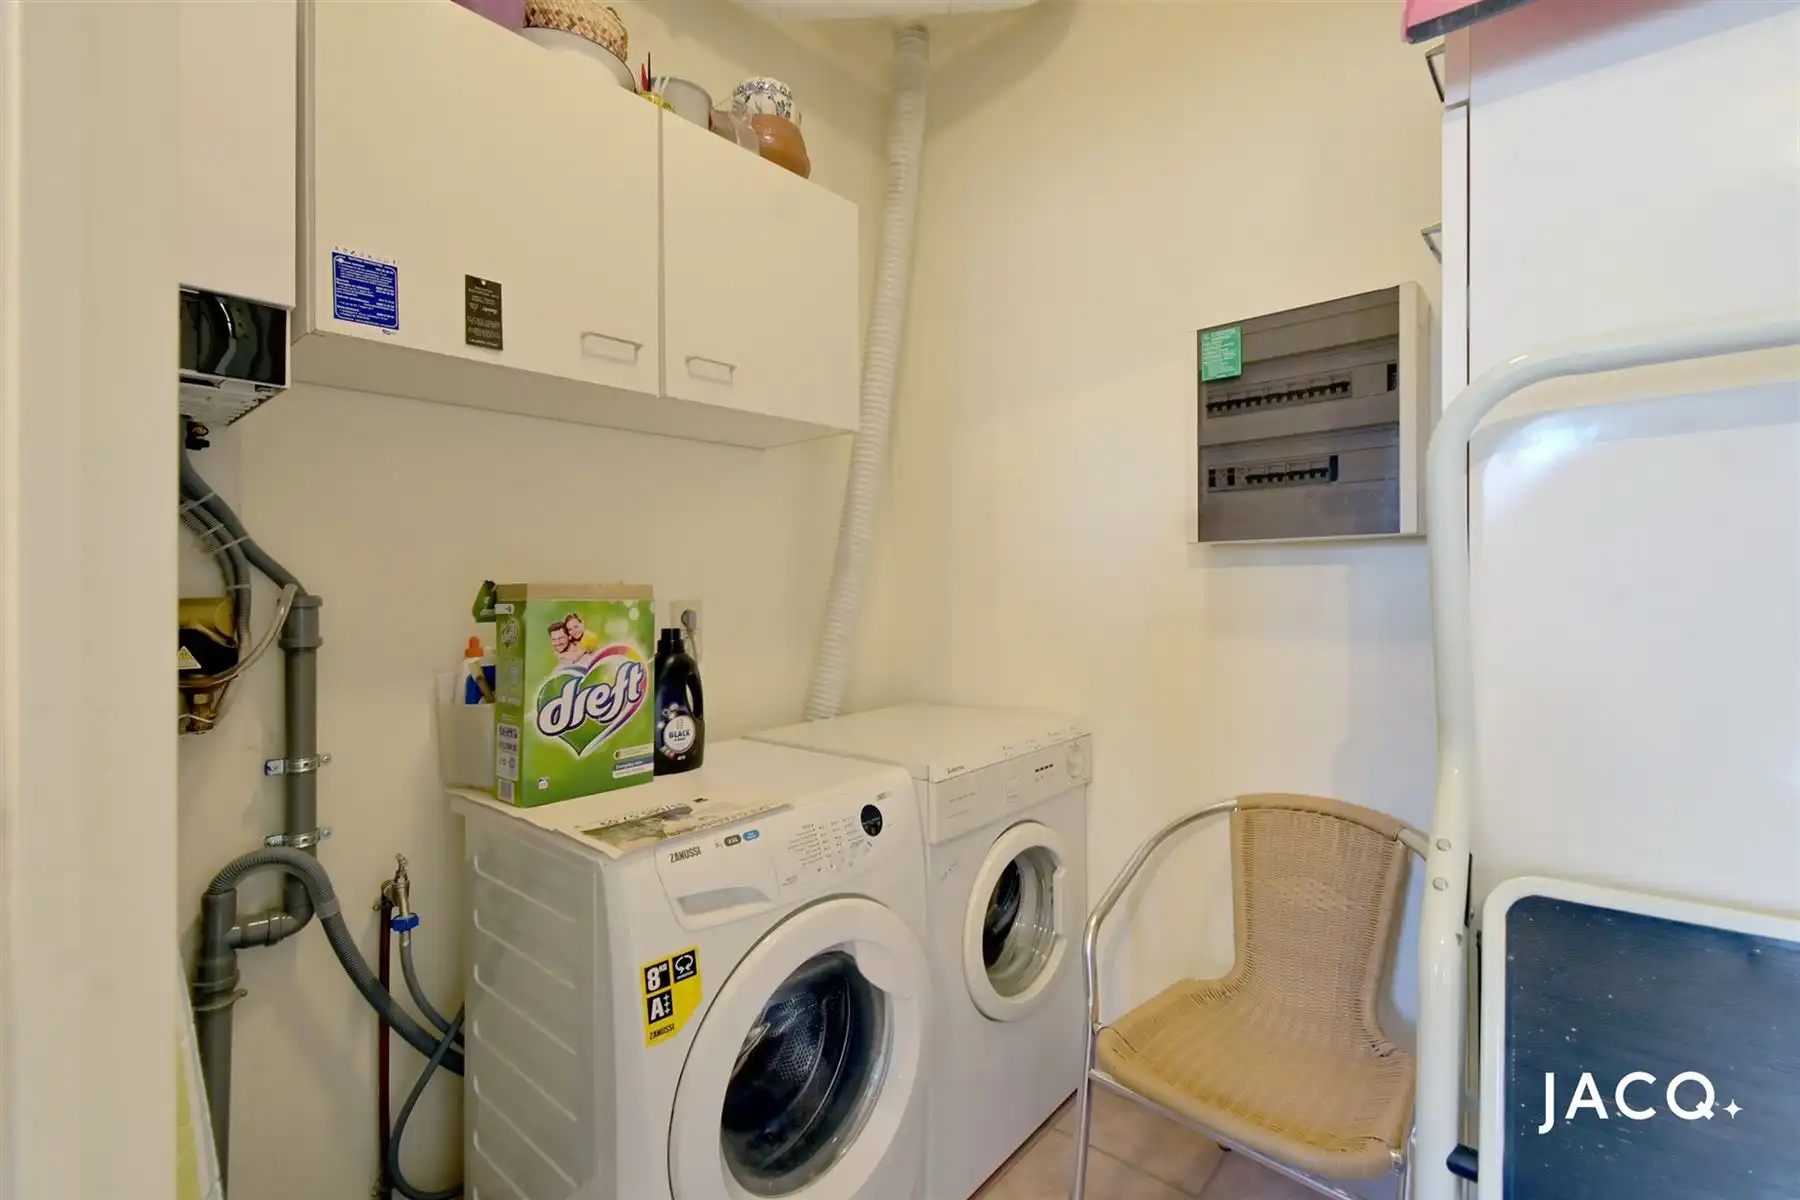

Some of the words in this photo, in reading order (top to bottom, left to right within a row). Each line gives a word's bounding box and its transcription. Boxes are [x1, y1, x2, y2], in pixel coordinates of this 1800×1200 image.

[537, 661, 644, 736] dreft
[669, 730, 690, 738] BLACK
[669, 846, 701, 863] ZANUSSI
[649, 1023, 674, 1040] ZANUSSI
